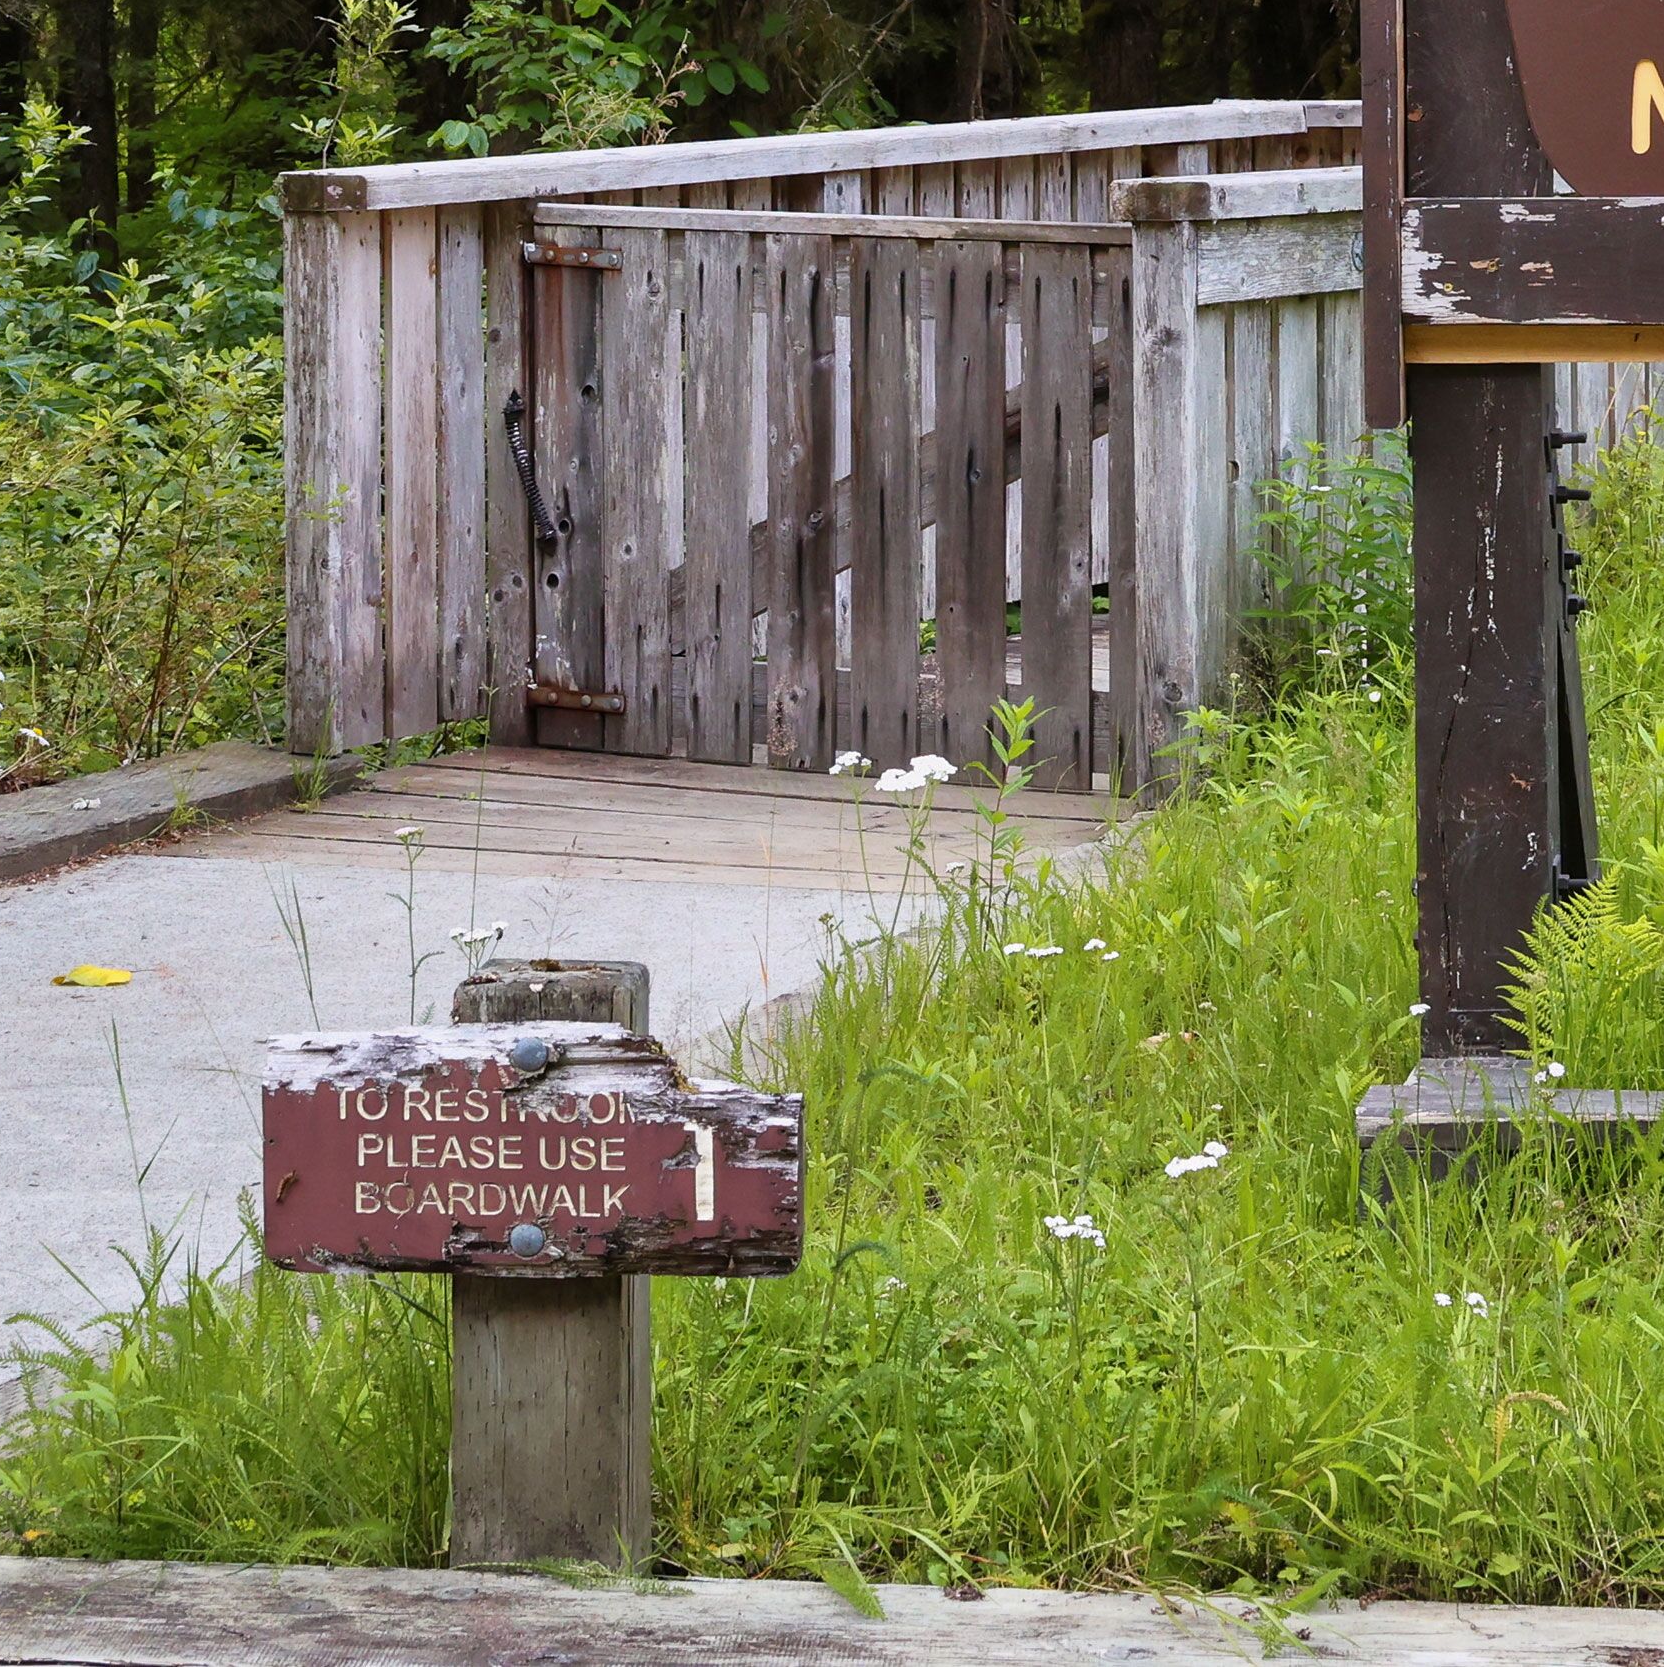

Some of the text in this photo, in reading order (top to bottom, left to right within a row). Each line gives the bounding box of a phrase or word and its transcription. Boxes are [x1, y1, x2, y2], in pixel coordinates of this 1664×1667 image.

[332, 1087, 389, 1121] TO
[357, 1133, 627, 1172] PLEASE USE
[354, 1181, 632, 1218] BOARDWALK
